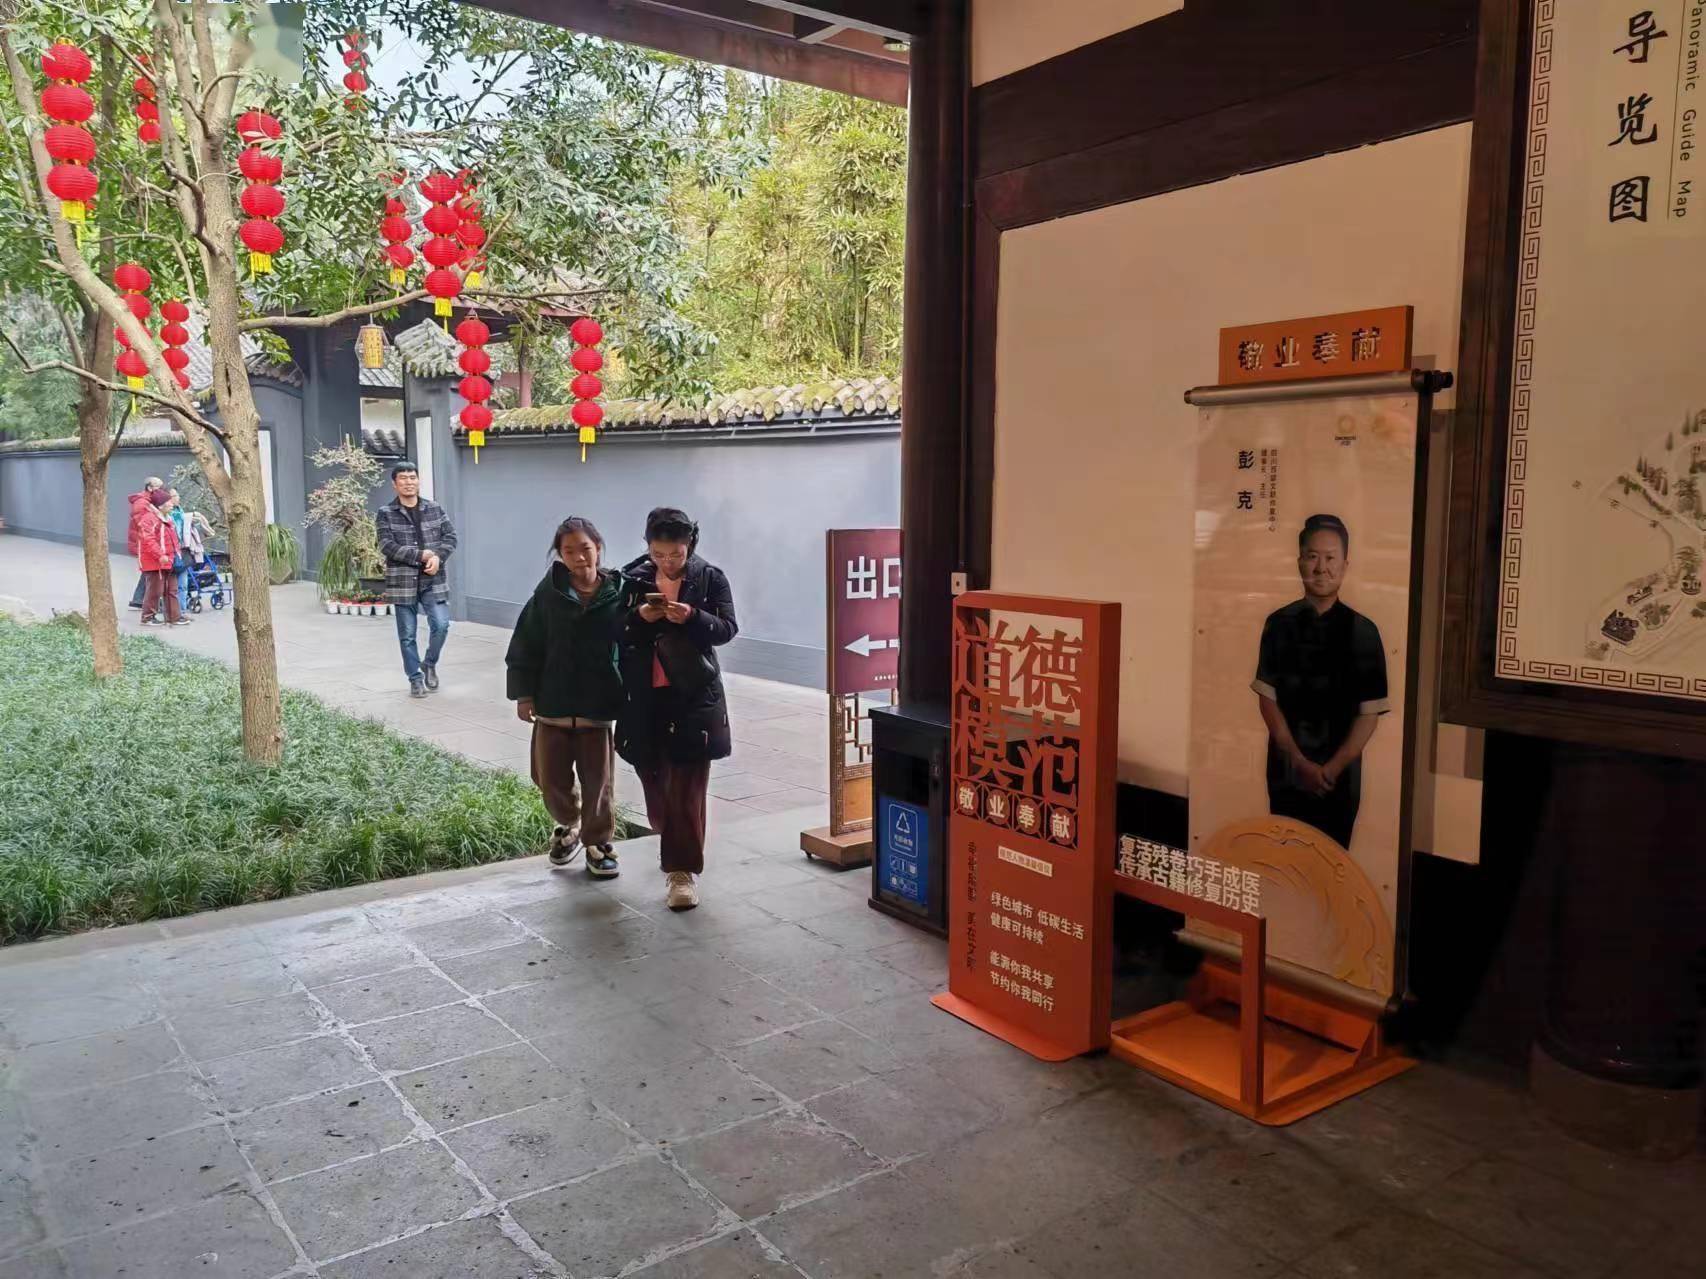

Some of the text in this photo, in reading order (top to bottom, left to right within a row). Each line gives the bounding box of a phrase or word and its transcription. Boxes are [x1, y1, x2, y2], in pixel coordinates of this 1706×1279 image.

[1608, 10, 1668, 223] 导览图
[1680, 109, 1696, 161] Guide
[1672, 181, 1692, 218] Map
[959, 786, 1070, 838] 敬业奉献
[1119, 858, 1261, 917] 传承古籍修复历史
[990, 911, 1044, 944] 健康可持续
[991, 891, 1084, 940] 绿色城市 低碳生活
[990, 950, 1054, 990] 能源你我共享
[990, 970, 1054, 1012] 节约你我同行
